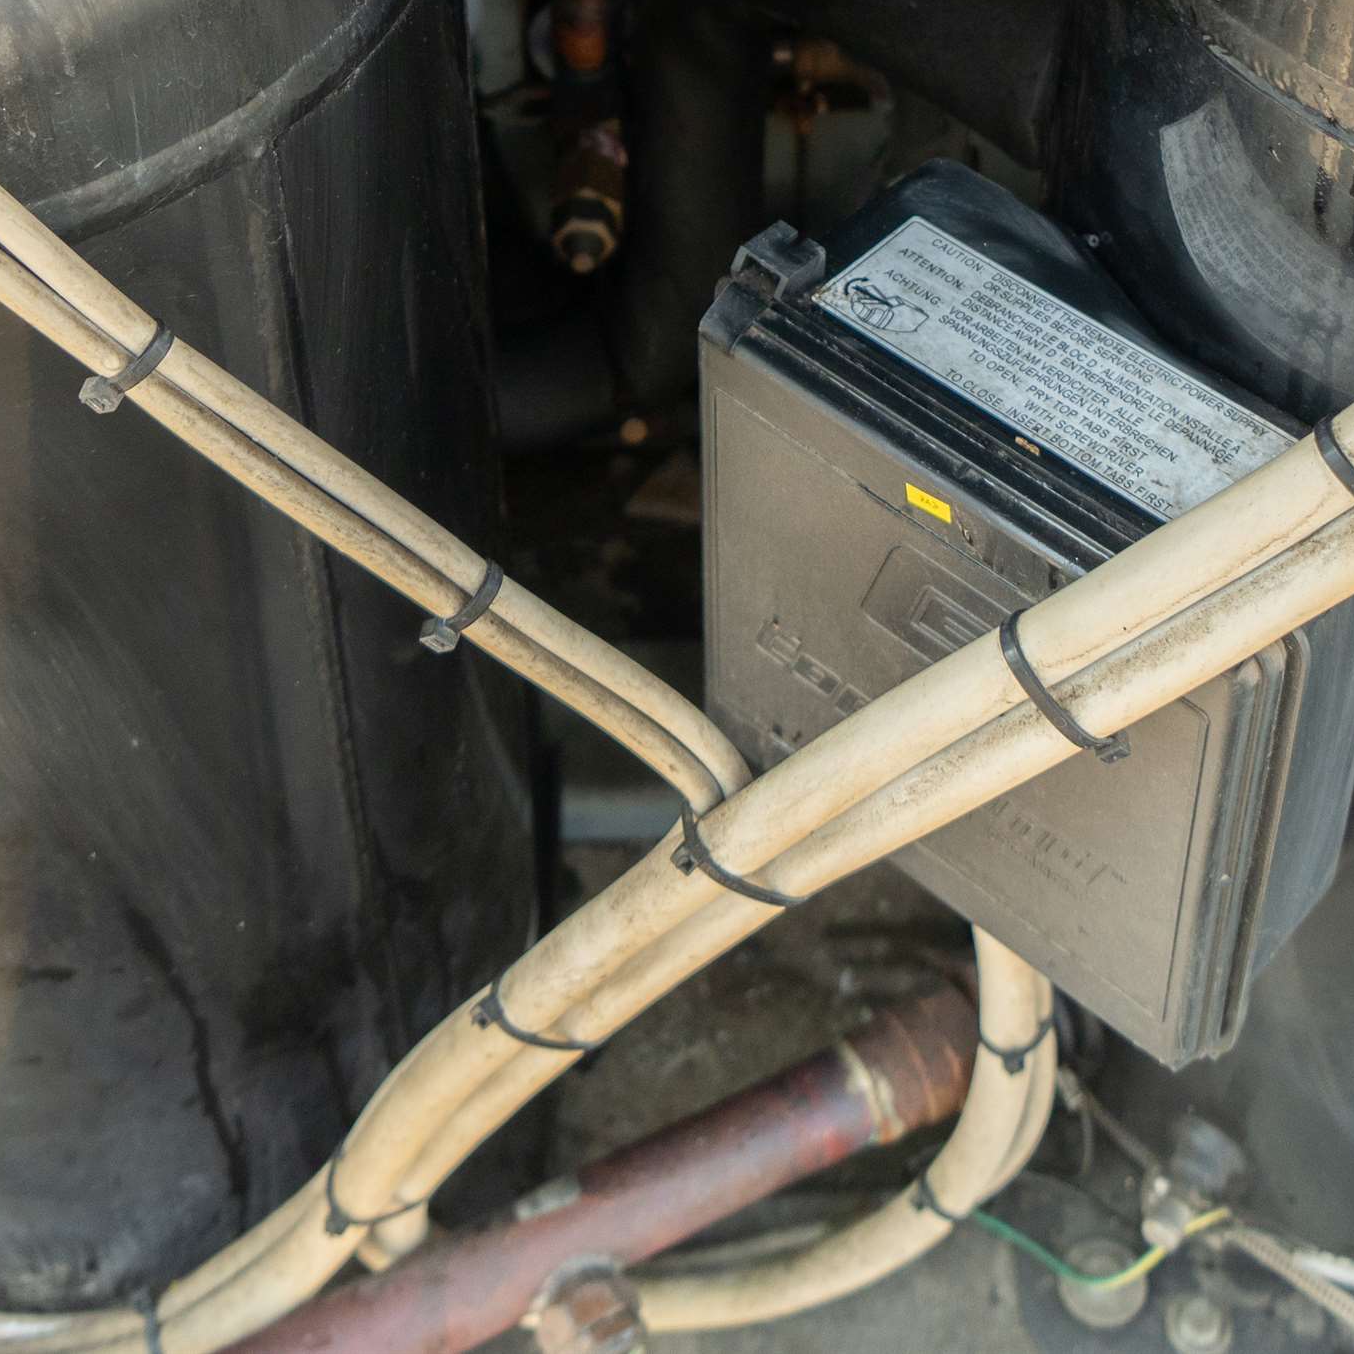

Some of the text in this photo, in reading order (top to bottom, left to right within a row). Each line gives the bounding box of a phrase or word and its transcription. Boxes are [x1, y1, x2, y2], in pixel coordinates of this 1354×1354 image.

[936, 314, 1088, 407] SPANNUNGSZUFUEHRUNGEN
[946, 306, 974, 324] VOR
[970, 320, 1024, 355] ARBEITEN
[1112, 406, 1144, 427] ALLE
[960, 297, 1014, 332] DISTANCE
[1010, 328, 1047, 352] AVANT
[1059, 357, 1149, 412] ENTREPRENDRE
[969, 289, 1044, 335] DEBRANCHER
[1055, 340, 1088, 362] BLOC
[1100, 367, 1180, 417] ALIMENTATION
[1177, 413, 1233, 448] INSTALLE
[990, 272, 1061, 315] DISCONNECT
[1057, 311, 1083, 328] THE
[1079, 324, 1128, 355] REMOTE
[1124, 351, 1182, 387] ELECTRIC
[1178, 382, 1225, 412] POWER
[1221, 408, 1269, 438] SUPPLY
[997, 289, 1052, 323] SUPPLIES
[1048, 319, 1095, 349] BEFORE
[1004, 406, 1051, 437] INSERT
[1048, 433, 1103, 468] BOTTOM
[1101, 465, 1136, 489] TABS
[1133, 485, 1174, 512] FIRST
[1021, 399, 1145, 477] WITH SCREWDRIVER
[1025, 384, 1052, 403] PRY
[1051, 400, 1078, 419] TOP
[1077, 416, 1110, 438] TABS
[1108, 435, 1148, 461] FIRST
